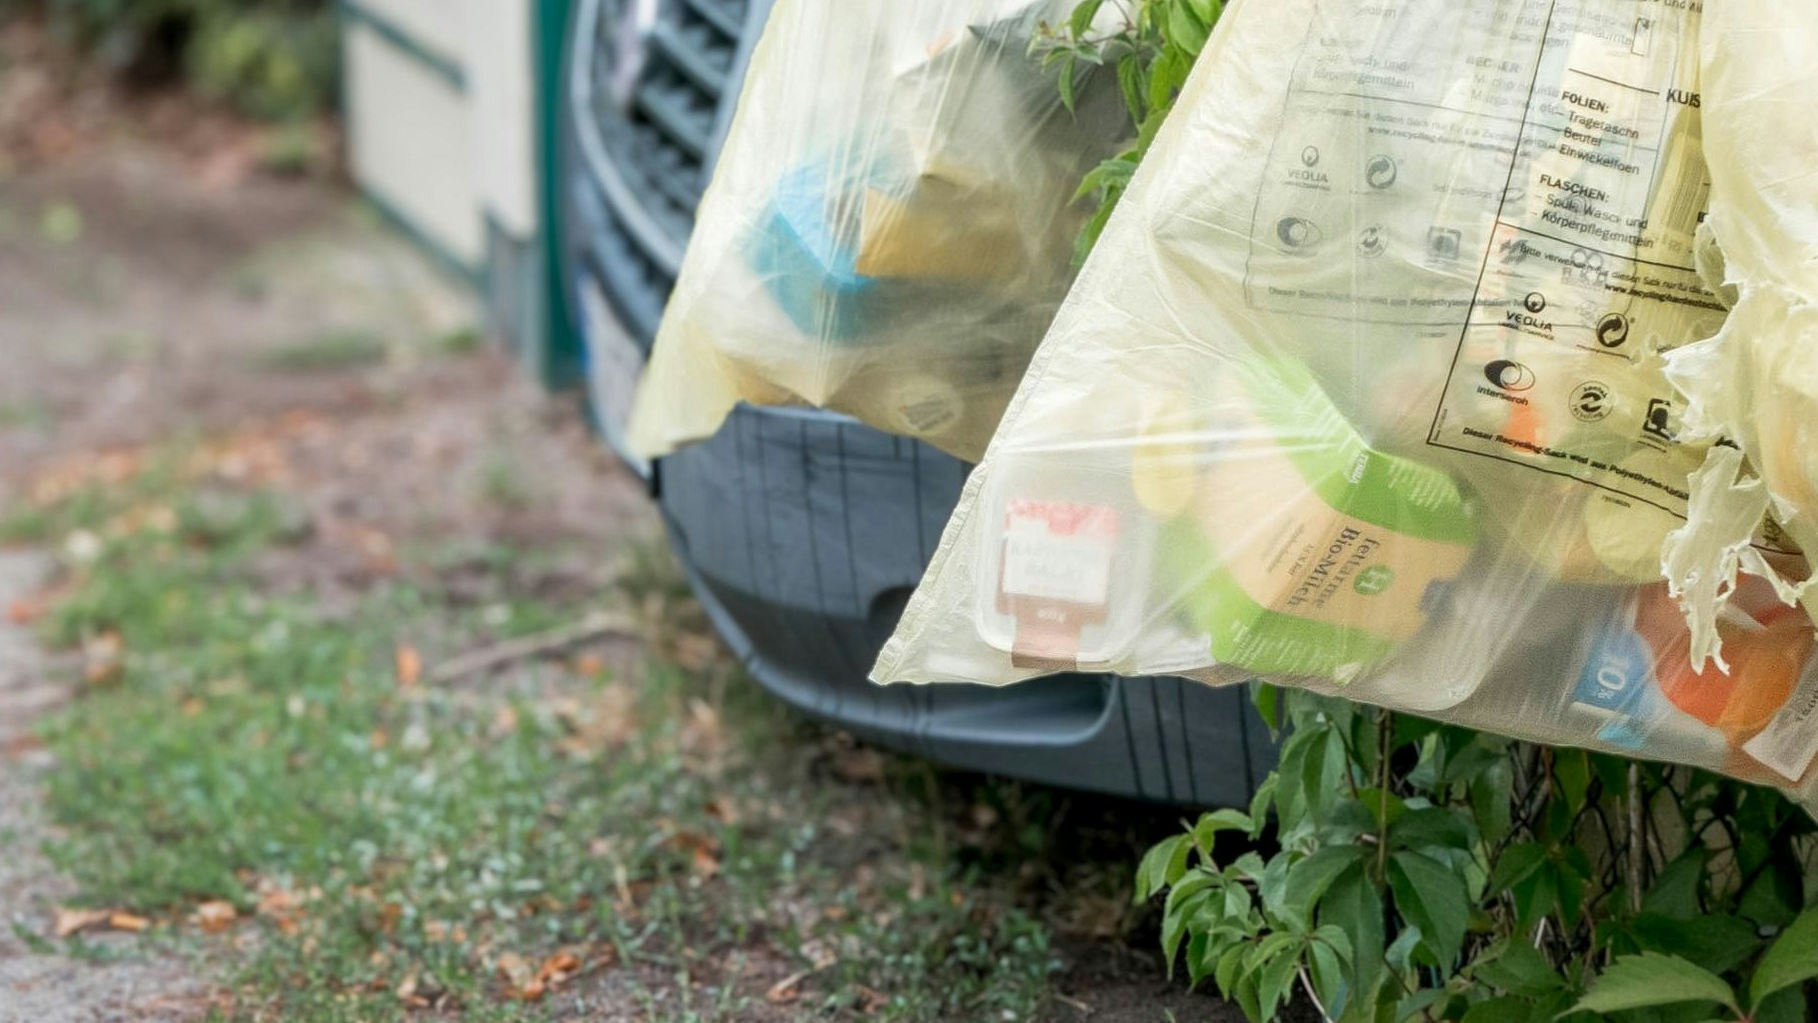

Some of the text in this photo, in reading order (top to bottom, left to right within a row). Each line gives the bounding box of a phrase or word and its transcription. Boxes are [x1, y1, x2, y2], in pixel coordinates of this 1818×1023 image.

[1561, 90, 1611, 115] FOLIEN:
[1539, 173, 1611, 203] FLASCHEN:
[1506, 309, 1553, 333] VEOLIA
[1476, 384, 1529, 407] interseroh
[1462, 426, 1493, 442] Dieser
[1287, 525, 1362, 607] Bio-Milch
